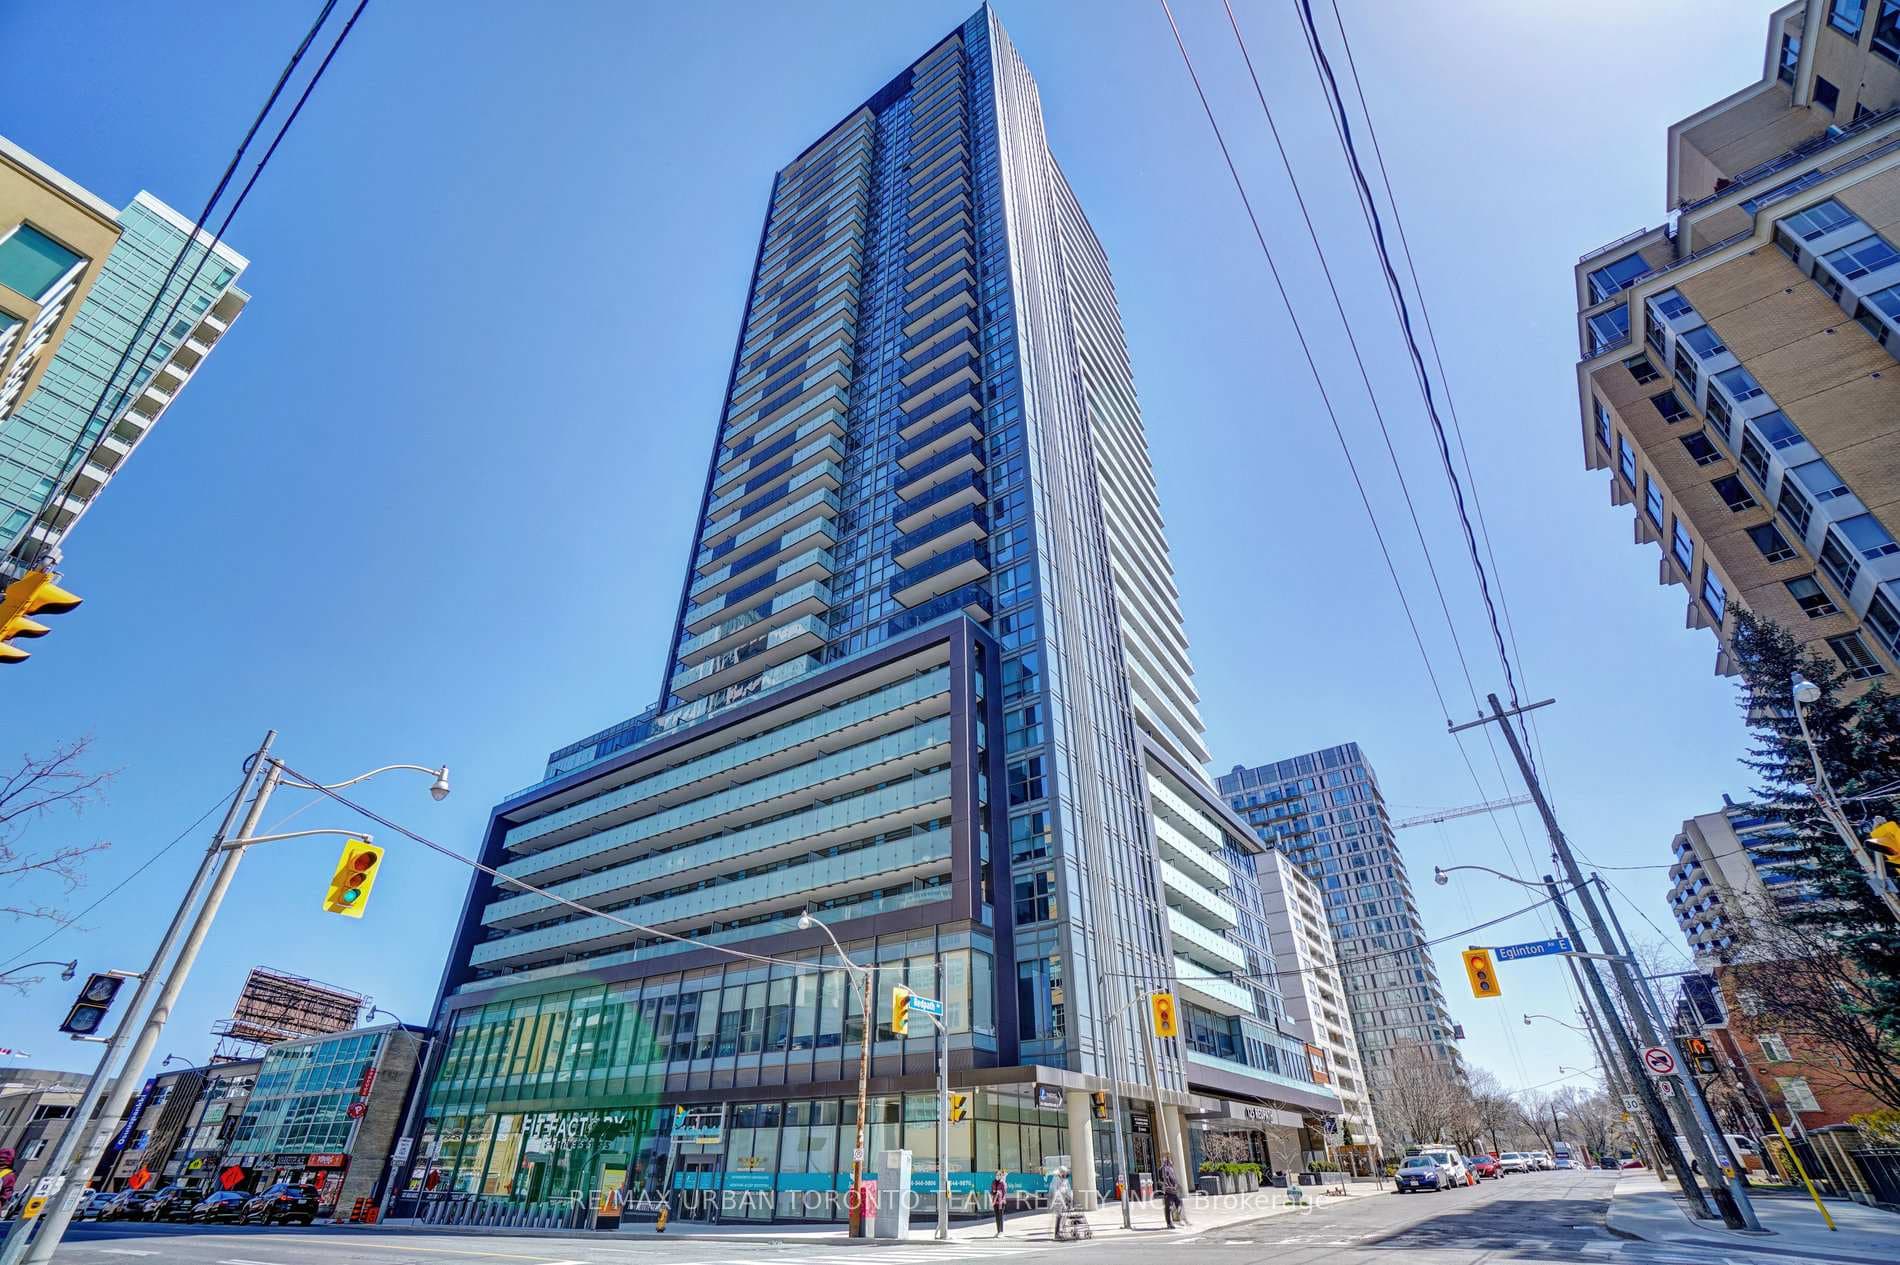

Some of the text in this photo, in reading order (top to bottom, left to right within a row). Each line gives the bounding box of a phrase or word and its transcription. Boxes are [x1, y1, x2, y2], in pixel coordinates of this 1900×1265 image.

[1499, 944, 1545, 959] Eglinton
[1558, 939, 1567, 949] E
[1624, 1099, 1639, 1109] 30
